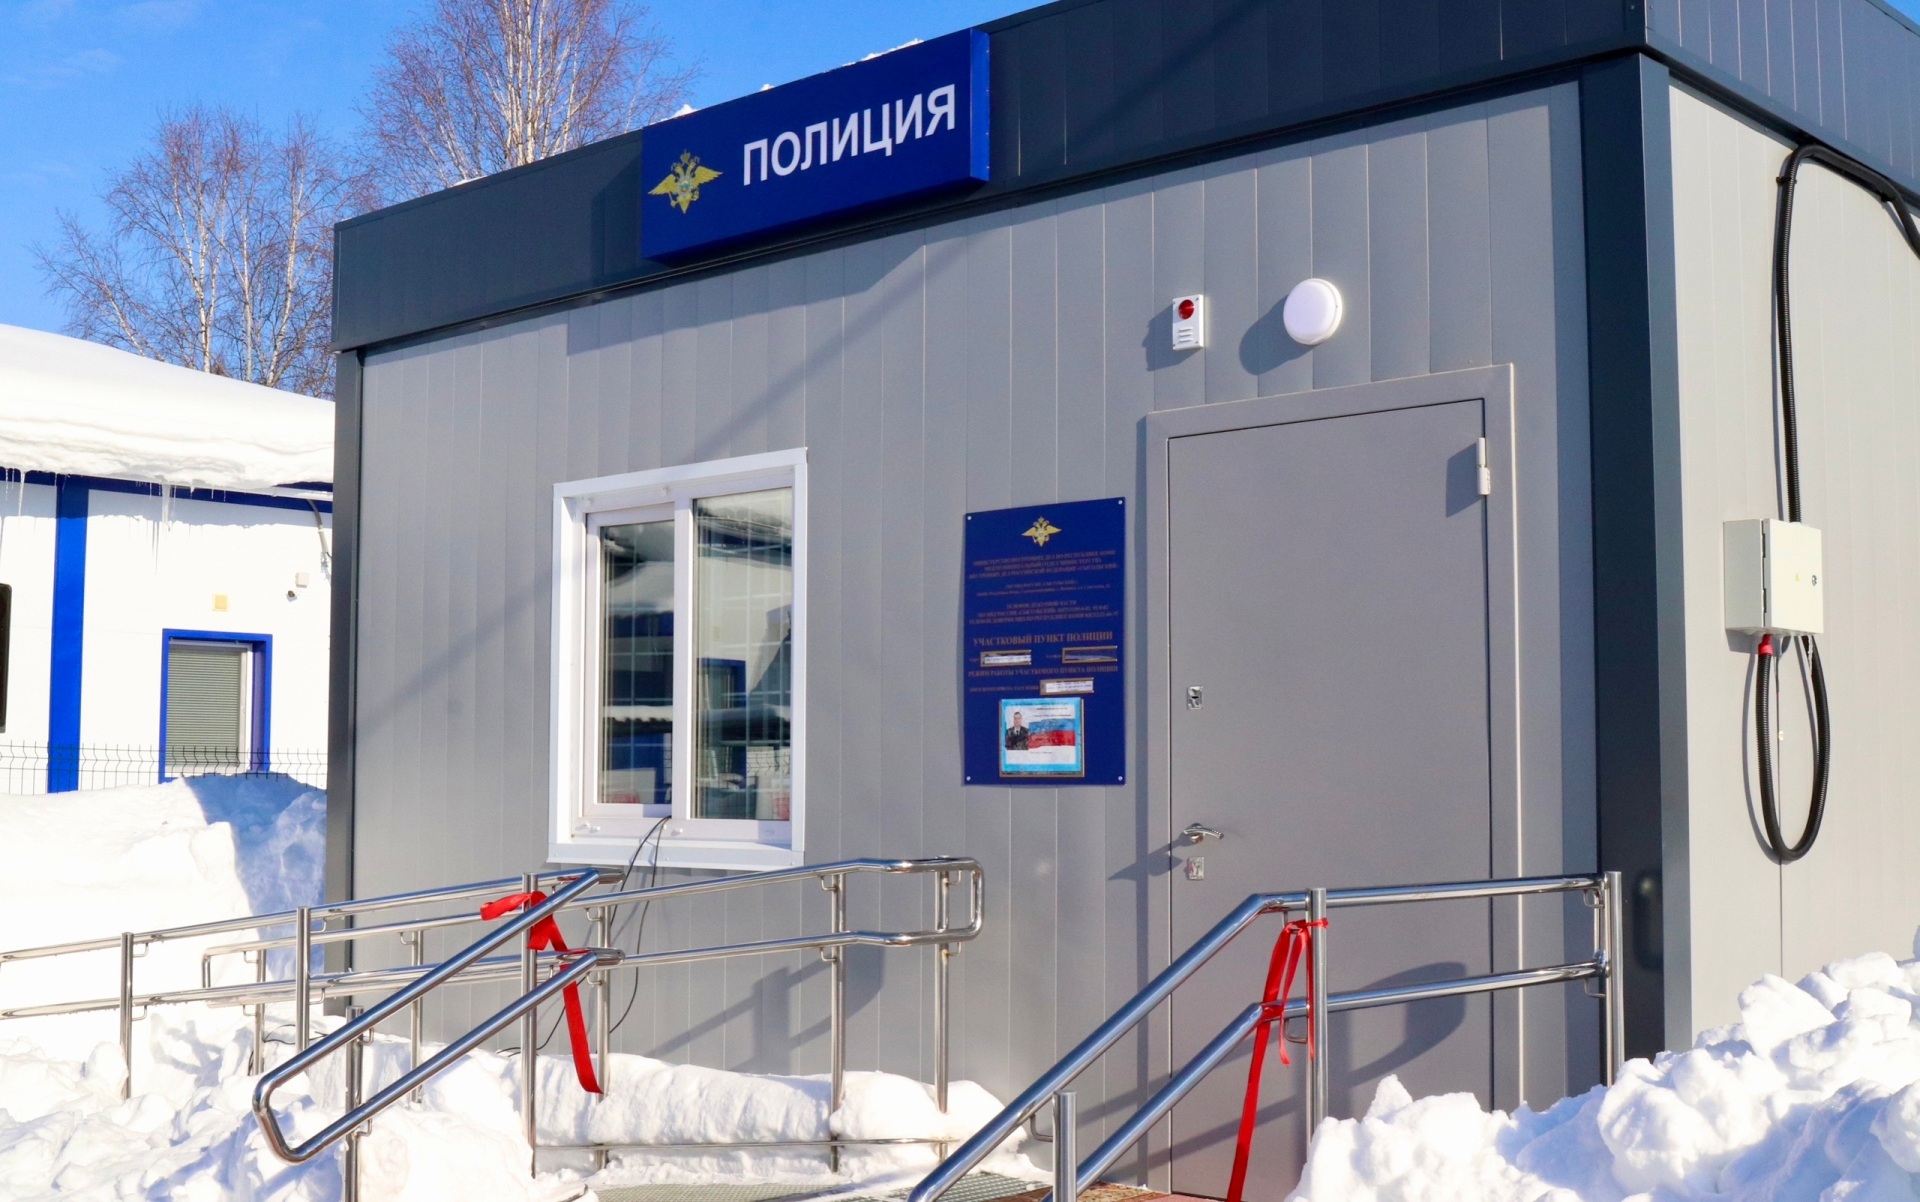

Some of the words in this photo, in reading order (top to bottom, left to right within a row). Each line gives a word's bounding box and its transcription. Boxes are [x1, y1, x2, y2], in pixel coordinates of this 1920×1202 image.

[743, 84, 955, 186] ПОЛИЦИЯ
[973, 634, 1032, 647] УЧАСТКОВЫЙ
[1034, 633, 1065, 644] ПУНКТ
[1066, 631, 1113, 642] ПОЛИЦИИ
